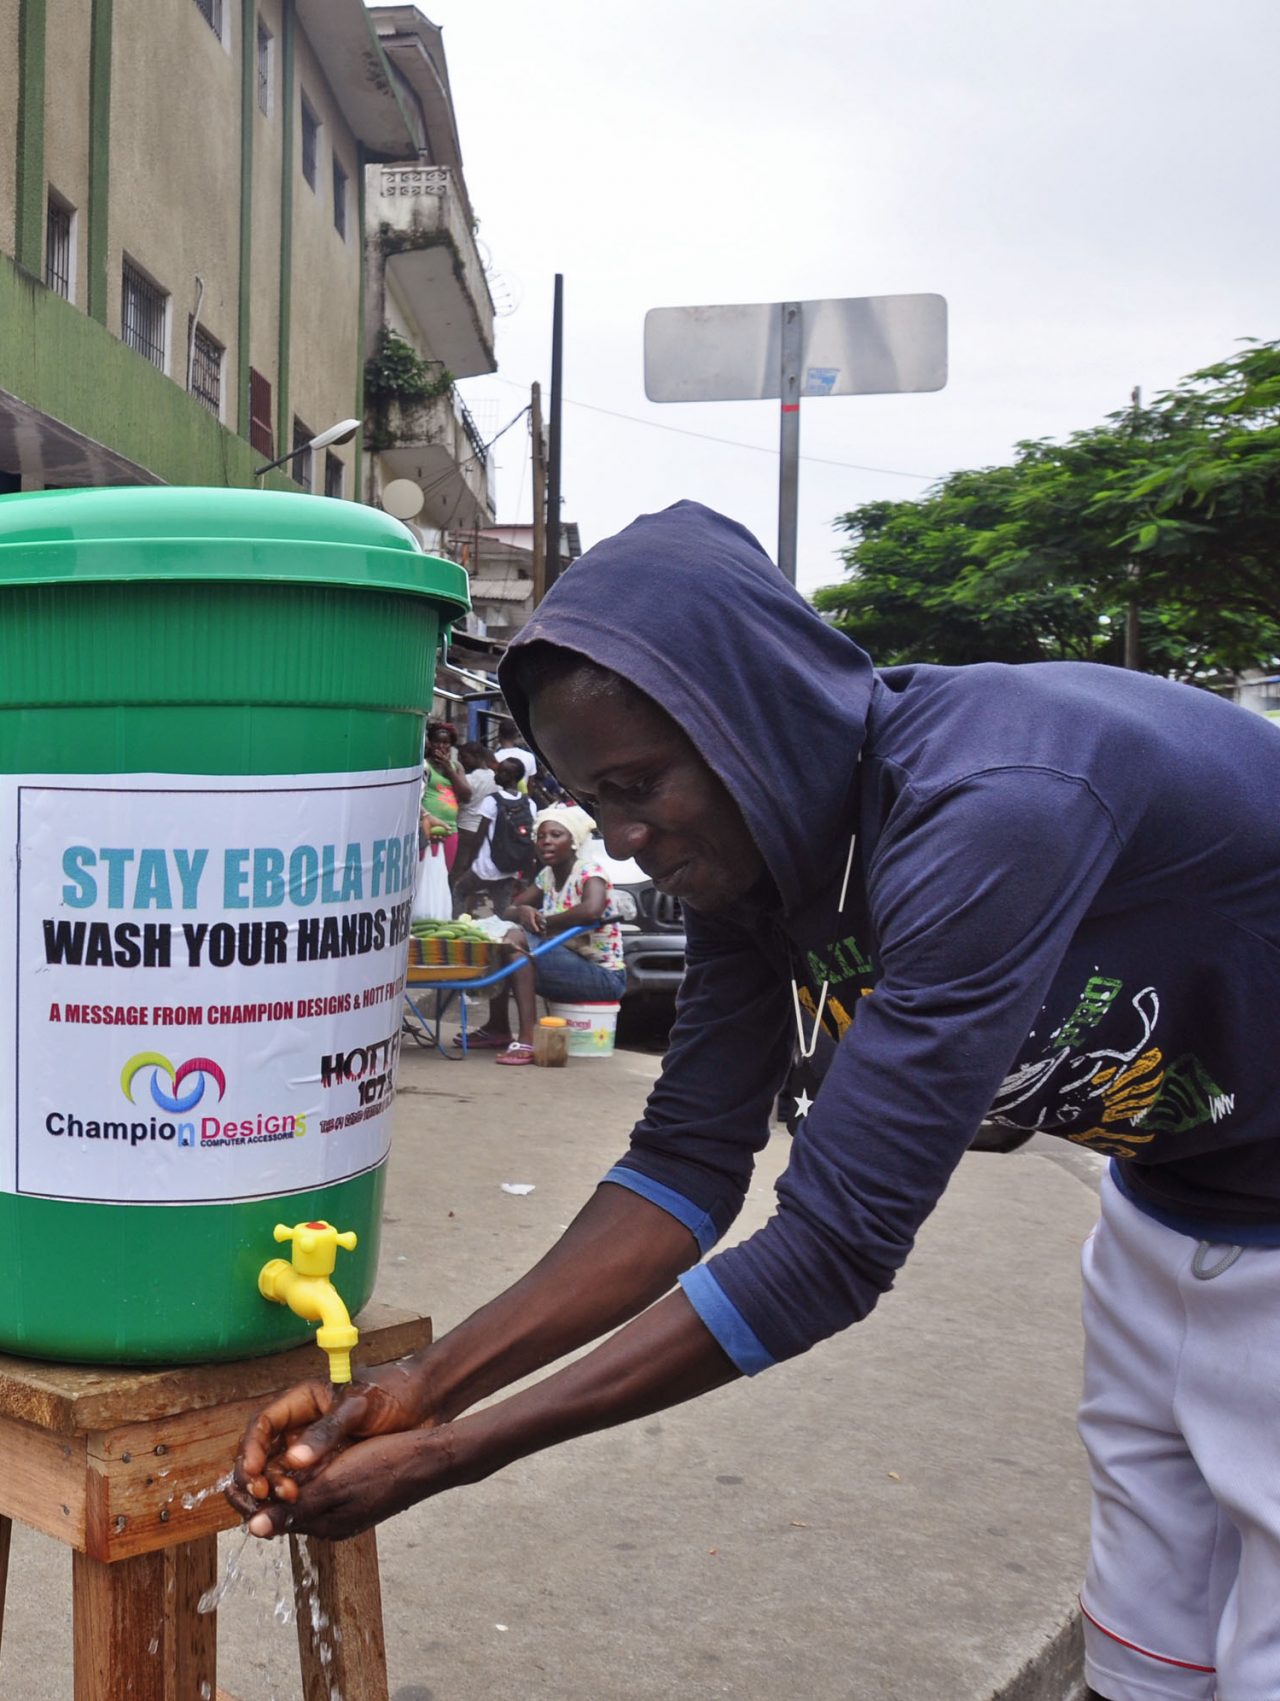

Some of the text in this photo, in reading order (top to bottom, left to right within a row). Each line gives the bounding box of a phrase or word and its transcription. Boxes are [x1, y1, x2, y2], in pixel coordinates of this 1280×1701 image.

[62, 846, 209, 909] STAY
[223, 842, 363, 909] EBOLA
[42, 917, 171, 967] WASH
[182, 921, 288, 967] YOUR
[297, 909, 387, 962] HANDS
[49, 1003, 61, 1022] A
[65, 1004, 148, 1025] MESSAGE
[153, 1006, 203, 1026] FROM
[207, 1001, 293, 1025] CHAMPION
[297, 993, 351, 1018] DESIGNS
[353, 993, 361, 1010] &
[363, 984, 385, 1008] HOTT
[321, 1036, 392, 1088] HOTT
[46, 1112, 194, 1147] Champion
[200, 1136, 246, 1147] COMPUTER
